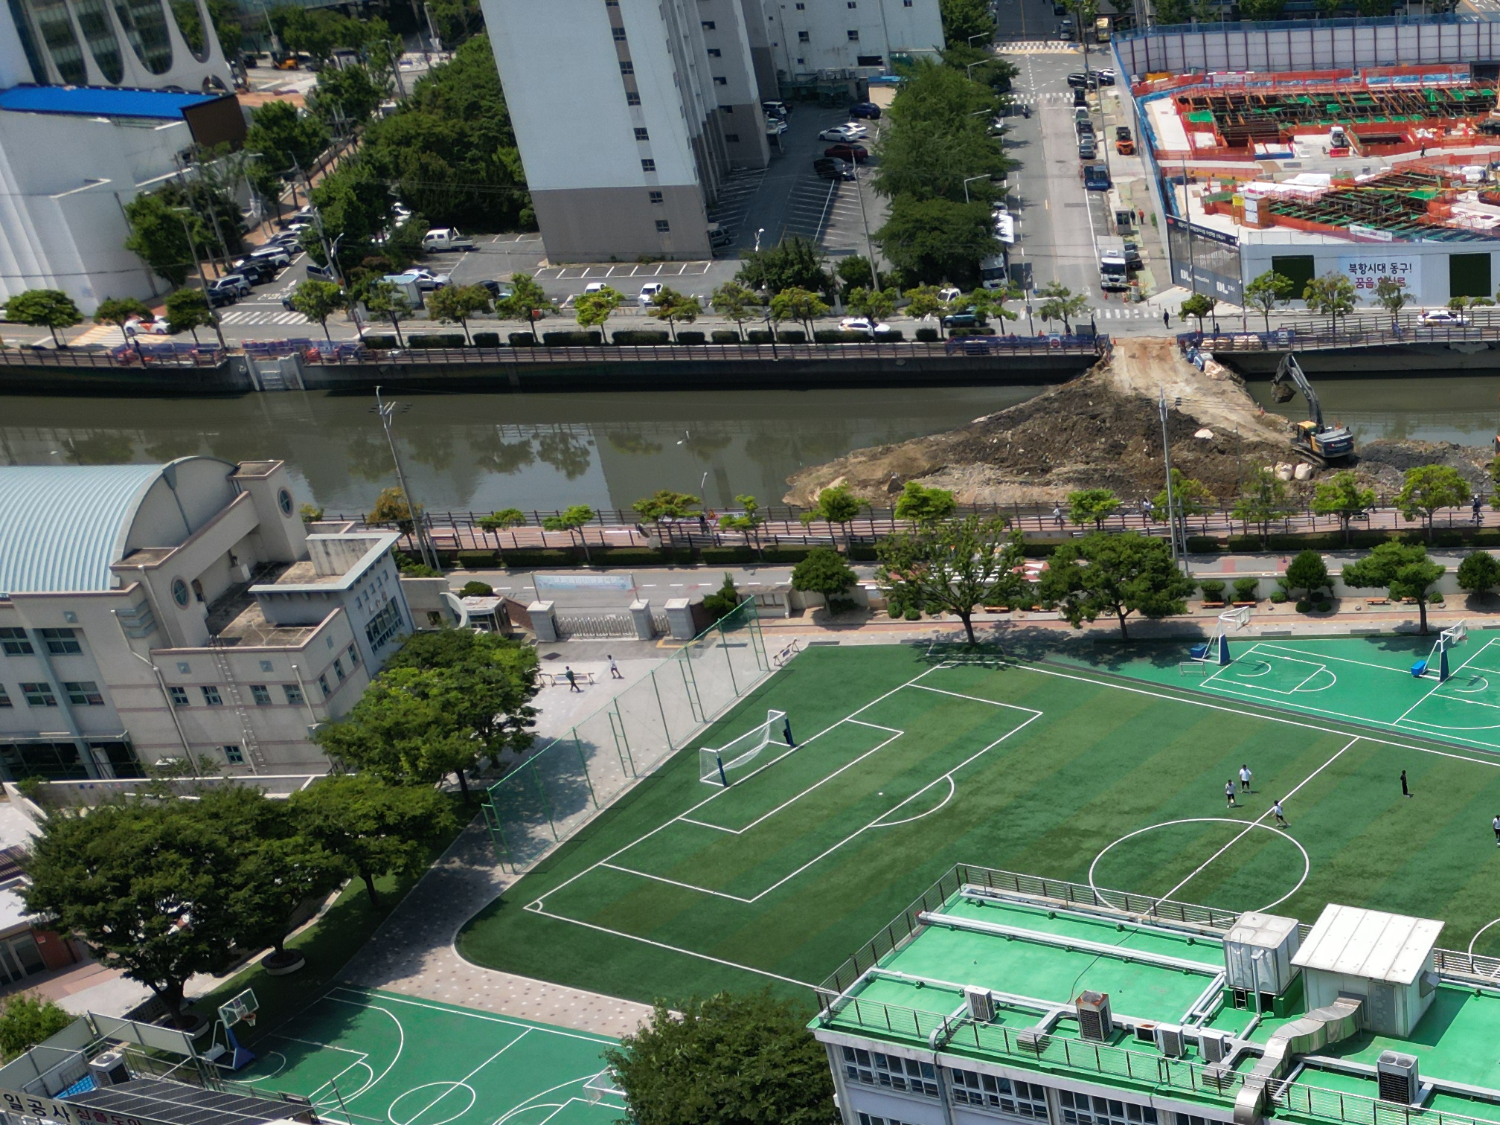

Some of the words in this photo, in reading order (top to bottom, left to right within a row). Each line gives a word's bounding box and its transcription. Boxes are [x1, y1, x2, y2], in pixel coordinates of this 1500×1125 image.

[1348, 262, 1386, 275] 북항시대
[1390, 262, 1412, 275] 동구!
[1355, 277, 1375, 289] 꿈을
